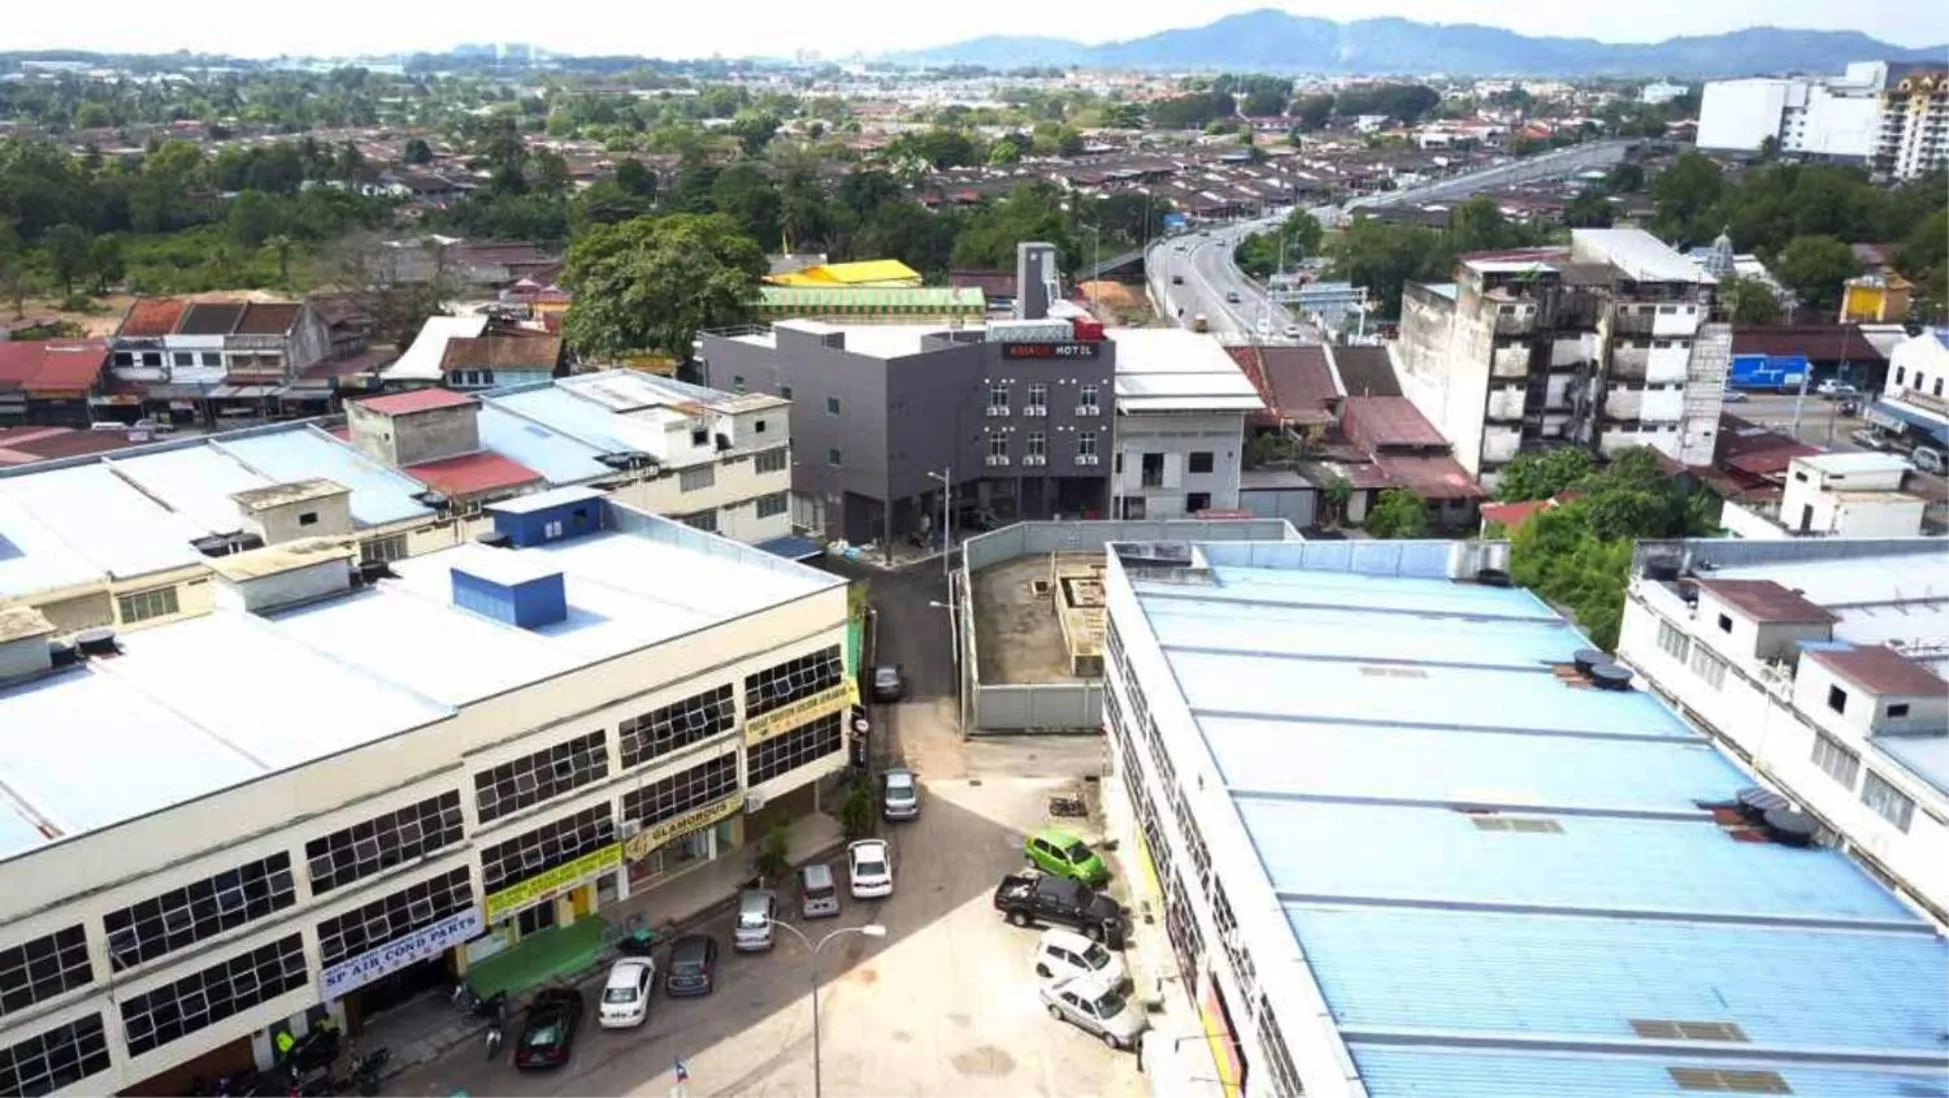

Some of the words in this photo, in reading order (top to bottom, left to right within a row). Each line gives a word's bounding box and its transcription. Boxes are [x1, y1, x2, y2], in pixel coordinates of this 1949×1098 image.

[1056, 345, 1093, 355] HOTEL
[653, 803, 727, 839] GLAMOROUS
[326, 971, 347, 986] SP
[352, 958, 380, 975] AIR
[384, 937, 426, 961] COND
[430, 917, 477, 942] PARTS
